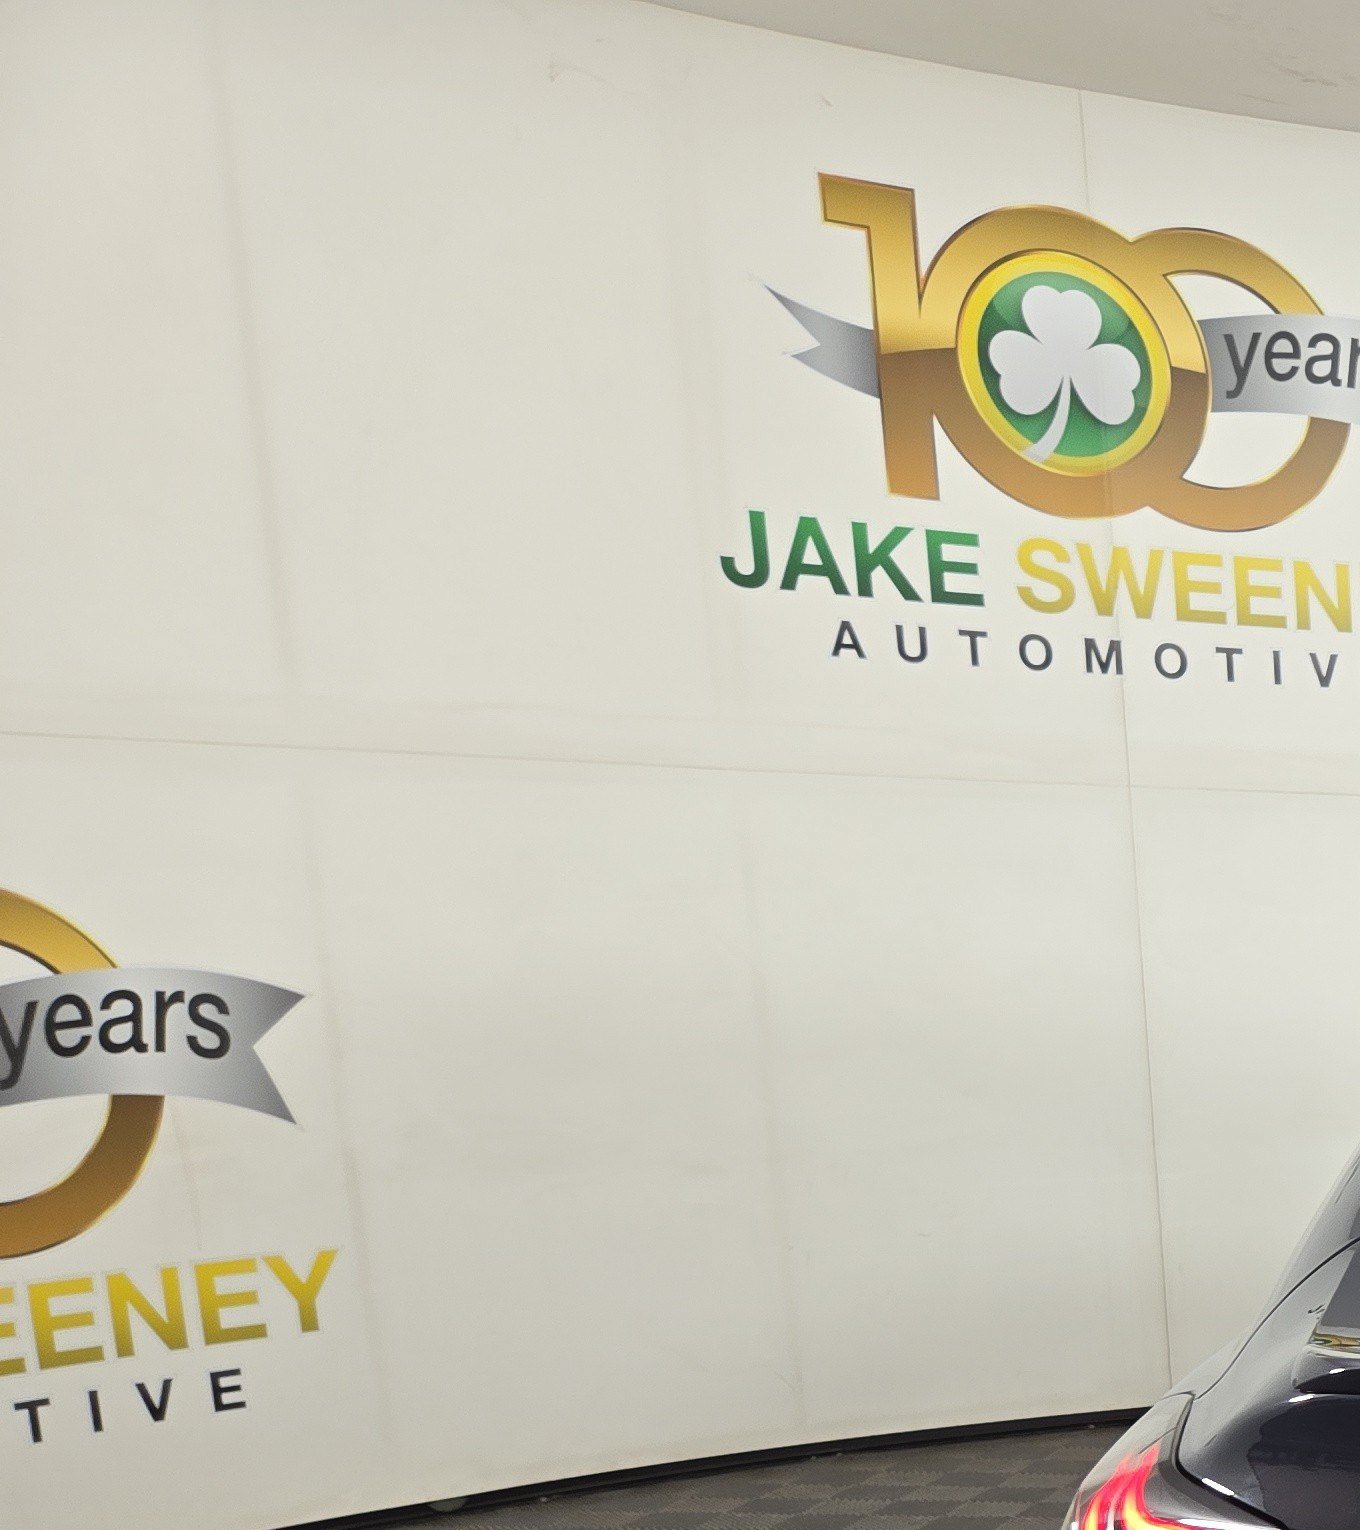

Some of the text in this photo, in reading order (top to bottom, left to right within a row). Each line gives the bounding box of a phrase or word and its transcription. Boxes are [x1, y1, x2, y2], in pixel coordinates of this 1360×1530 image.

[818, 171, 1351, 533] 100
[719, 508, 987, 608] JAKE
[0, 986, 231, 1091] years
